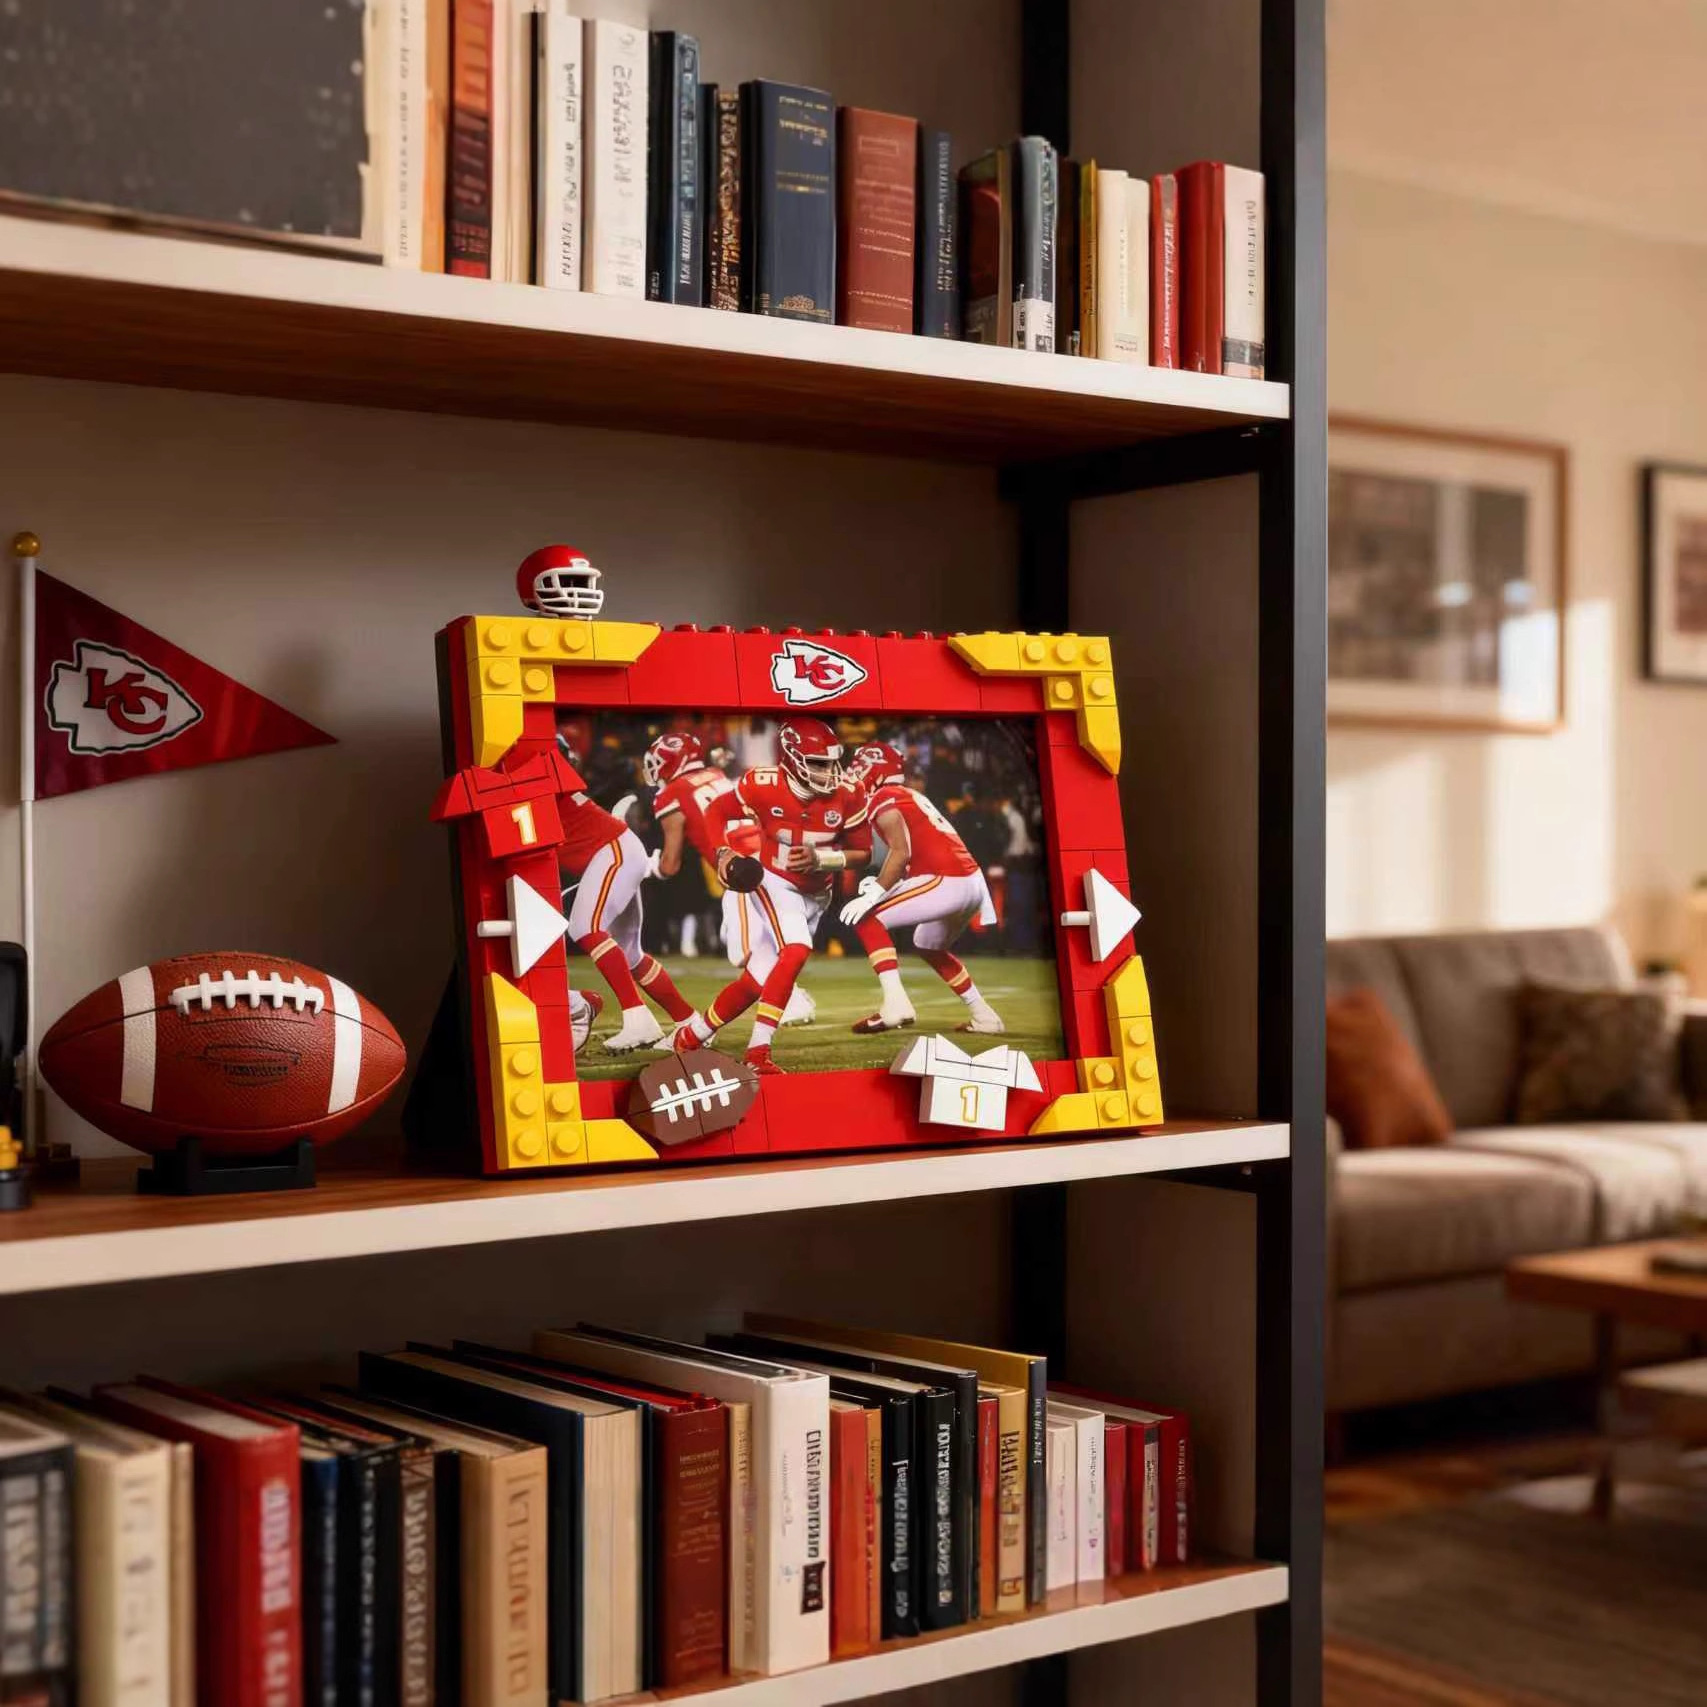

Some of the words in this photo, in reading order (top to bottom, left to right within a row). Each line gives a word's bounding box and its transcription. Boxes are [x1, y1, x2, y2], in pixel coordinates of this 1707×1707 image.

[792, 655, 846, 690] KC
[83, 667, 168, 735] KC
[511, 801, 538, 846] 1
[960, 1085, 979, 1123] 1
